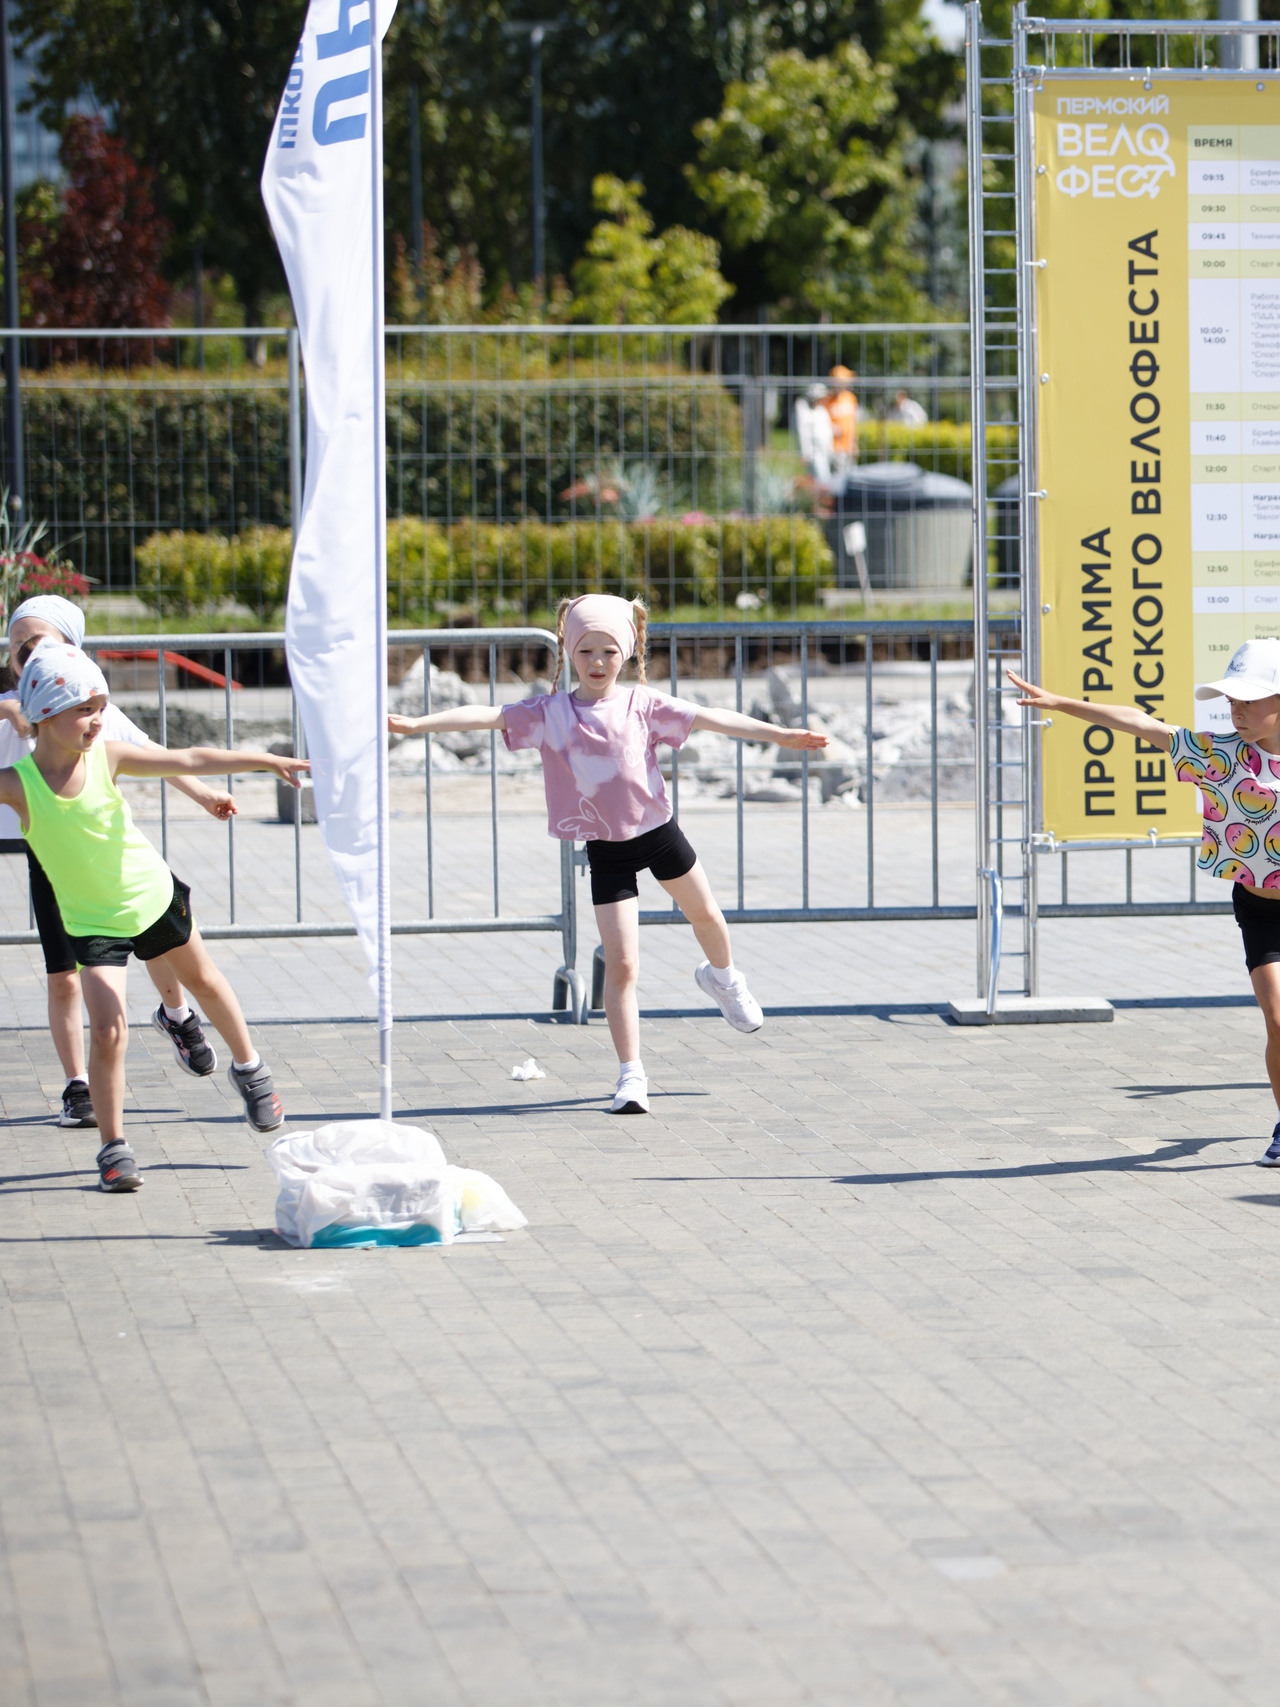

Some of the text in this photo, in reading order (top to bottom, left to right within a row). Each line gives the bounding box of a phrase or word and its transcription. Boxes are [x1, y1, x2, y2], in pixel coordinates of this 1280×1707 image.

[1057, 94, 1169, 115] ПЕРМСКИЙ
[1057, 121, 1171, 157] ВЕЛО
[1194, 138, 1233, 148] ВРЕМЯ
[1202, 173, 1224, 181] 09:15
[1202, 204, 1226, 212] 09:30
[1202, 232, 1226, 240] 09:45
[1202, 260, 1226, 268] 10:00
[1200, 327, 1223, 335] 10:00
[1203, 336, 1226, 344] 14:00
[1128, 228, 1162, 515] ВЕЛОФЕСТА
[1205, 403, 1226, 411] 11:30
[1205, 434, 1226, 442] 11:40
[1205, 465, 1227, 473] 12:00
[1206, 513, 1227, 521] 12:30
[1207, 565, 1228, 573] 12:50
[1207, 596, 1229, 604] 13:00
[1080, 527, 1115, 816] ПРОРАММА
